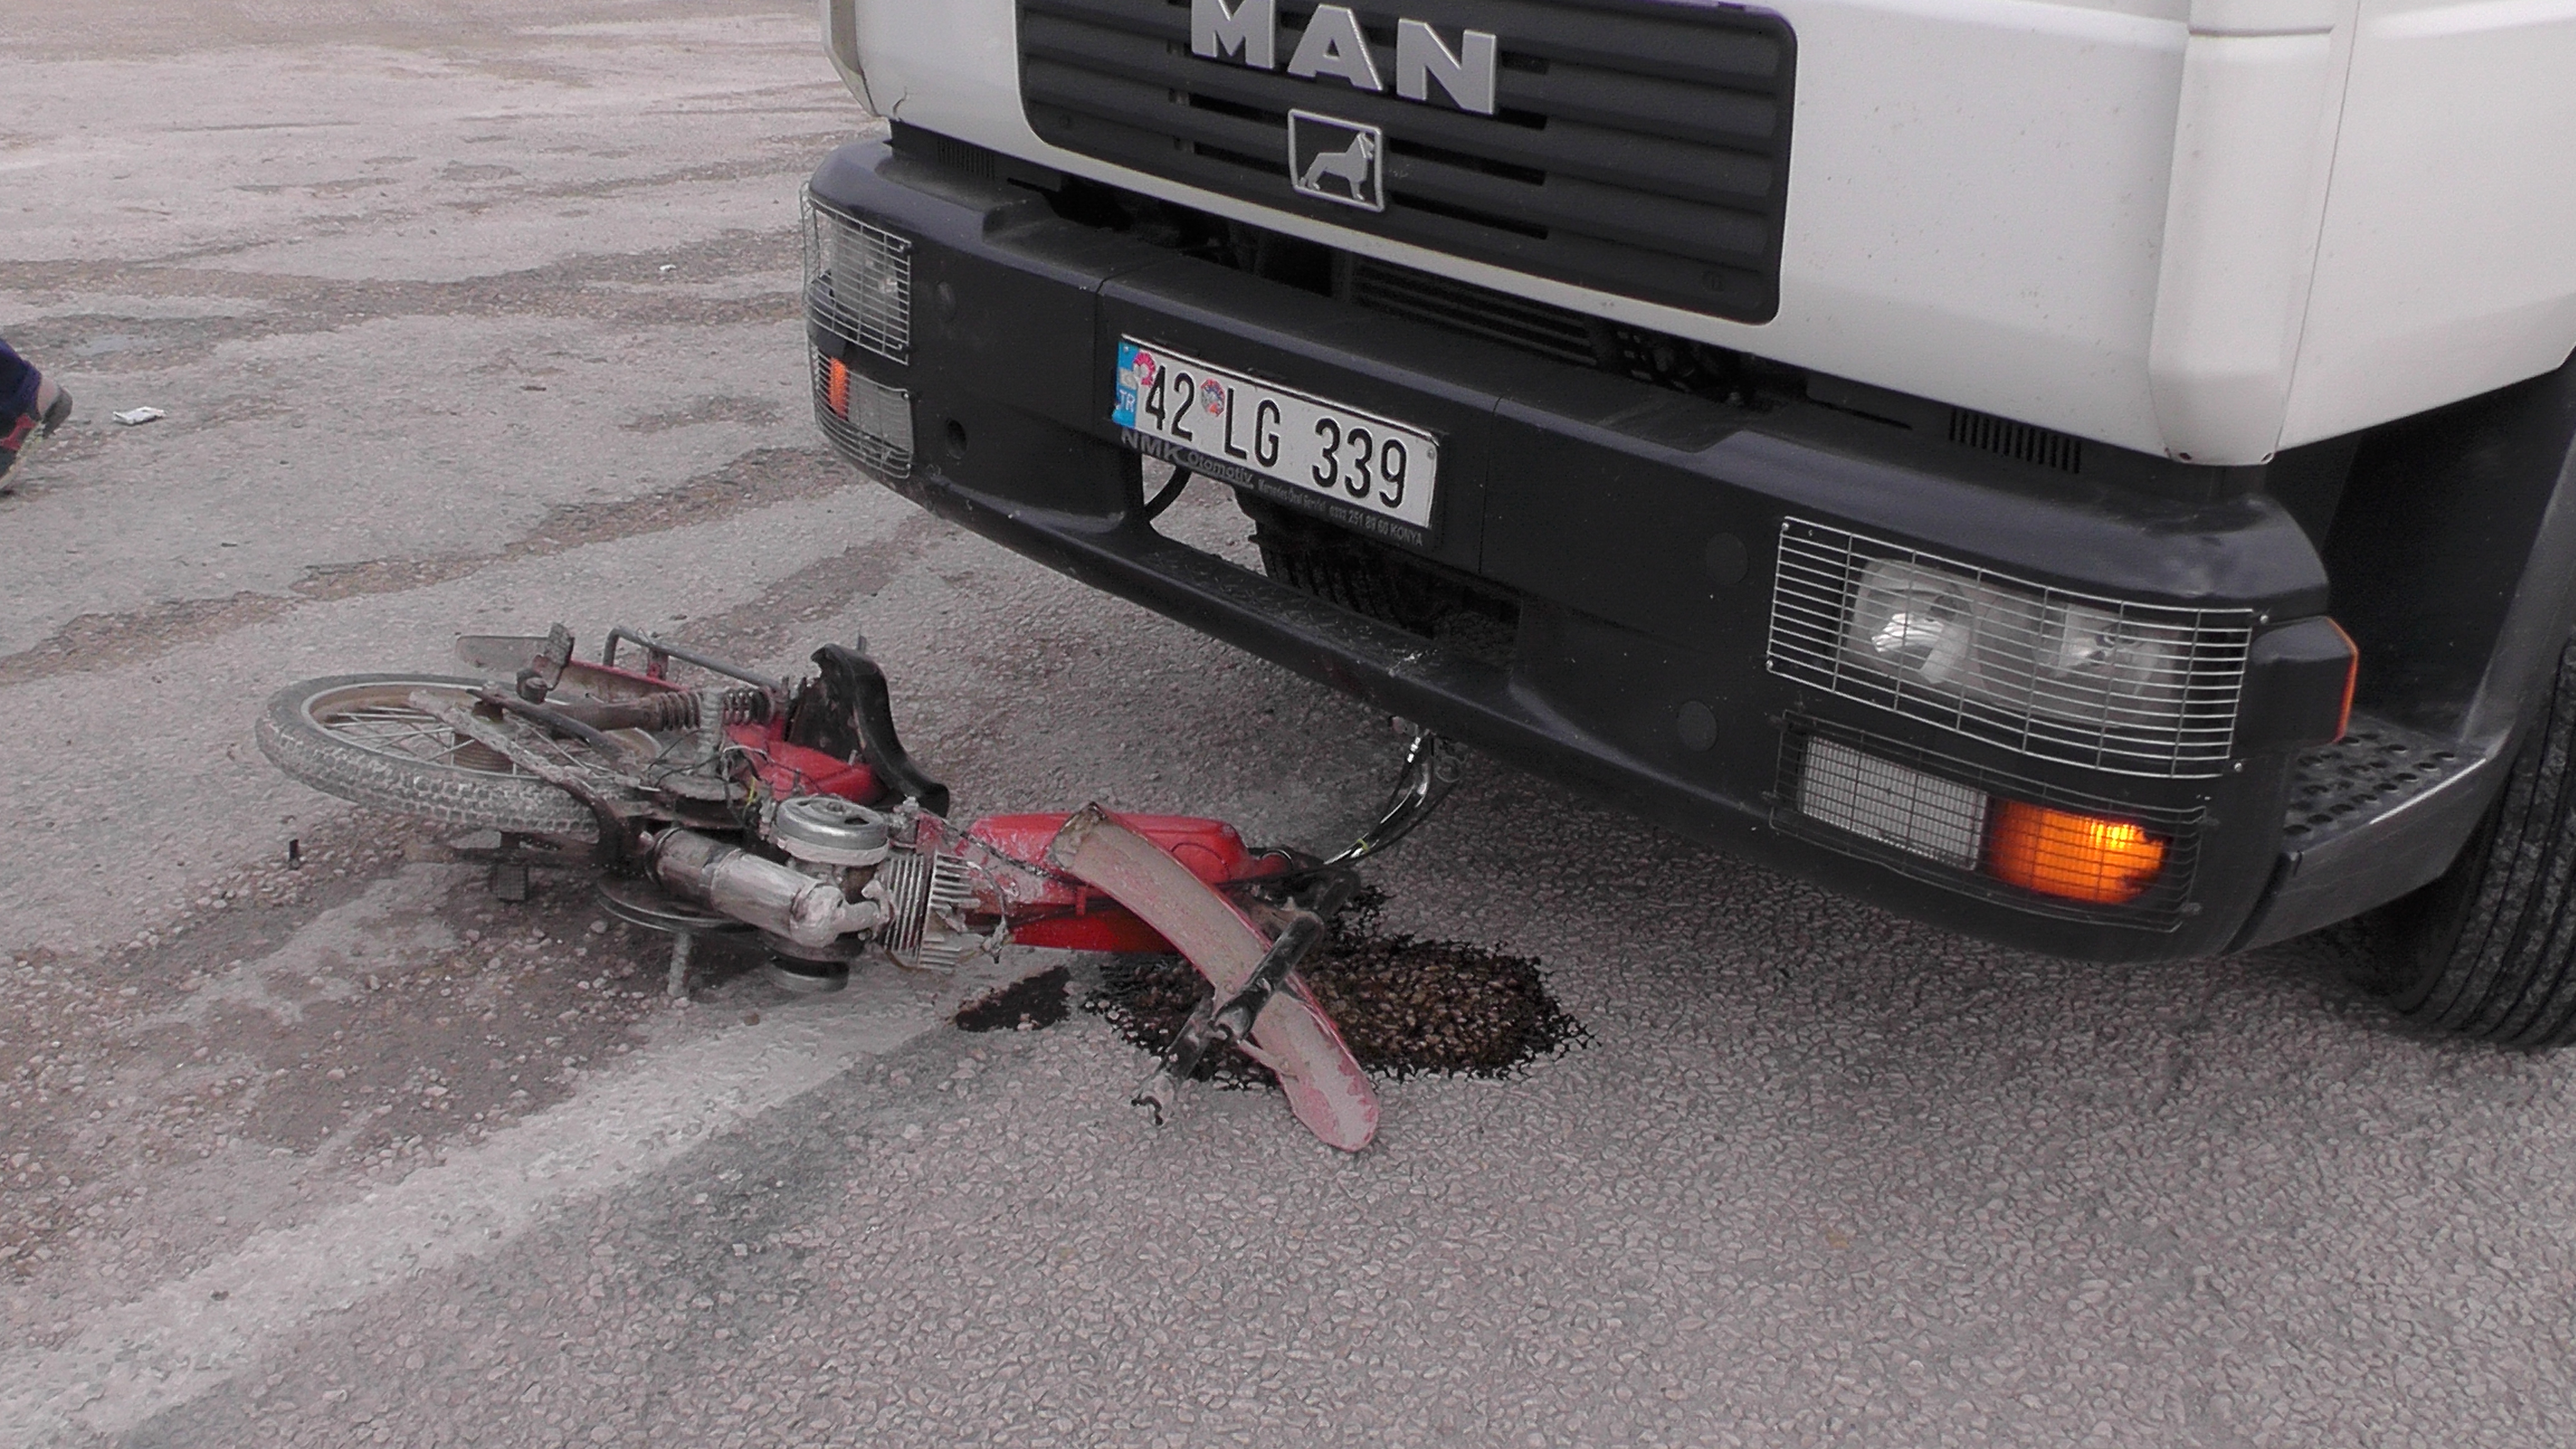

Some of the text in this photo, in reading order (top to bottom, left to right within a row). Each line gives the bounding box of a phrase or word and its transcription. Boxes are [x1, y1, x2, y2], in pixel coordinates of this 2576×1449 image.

[1191, 0, 1497, 114] MAN
[1119, 389, 1136, 413] TR
[1145, 364, 1195, 442] 42
[1224, 387, 1281, 468] LG
[1311, 418, 1407, 508] 339
[1121, 428, 1182, 462] NMK
[1187, 450, 1253, 484] Otomotiv
[1389, 522, 1423, 547] KONYA
